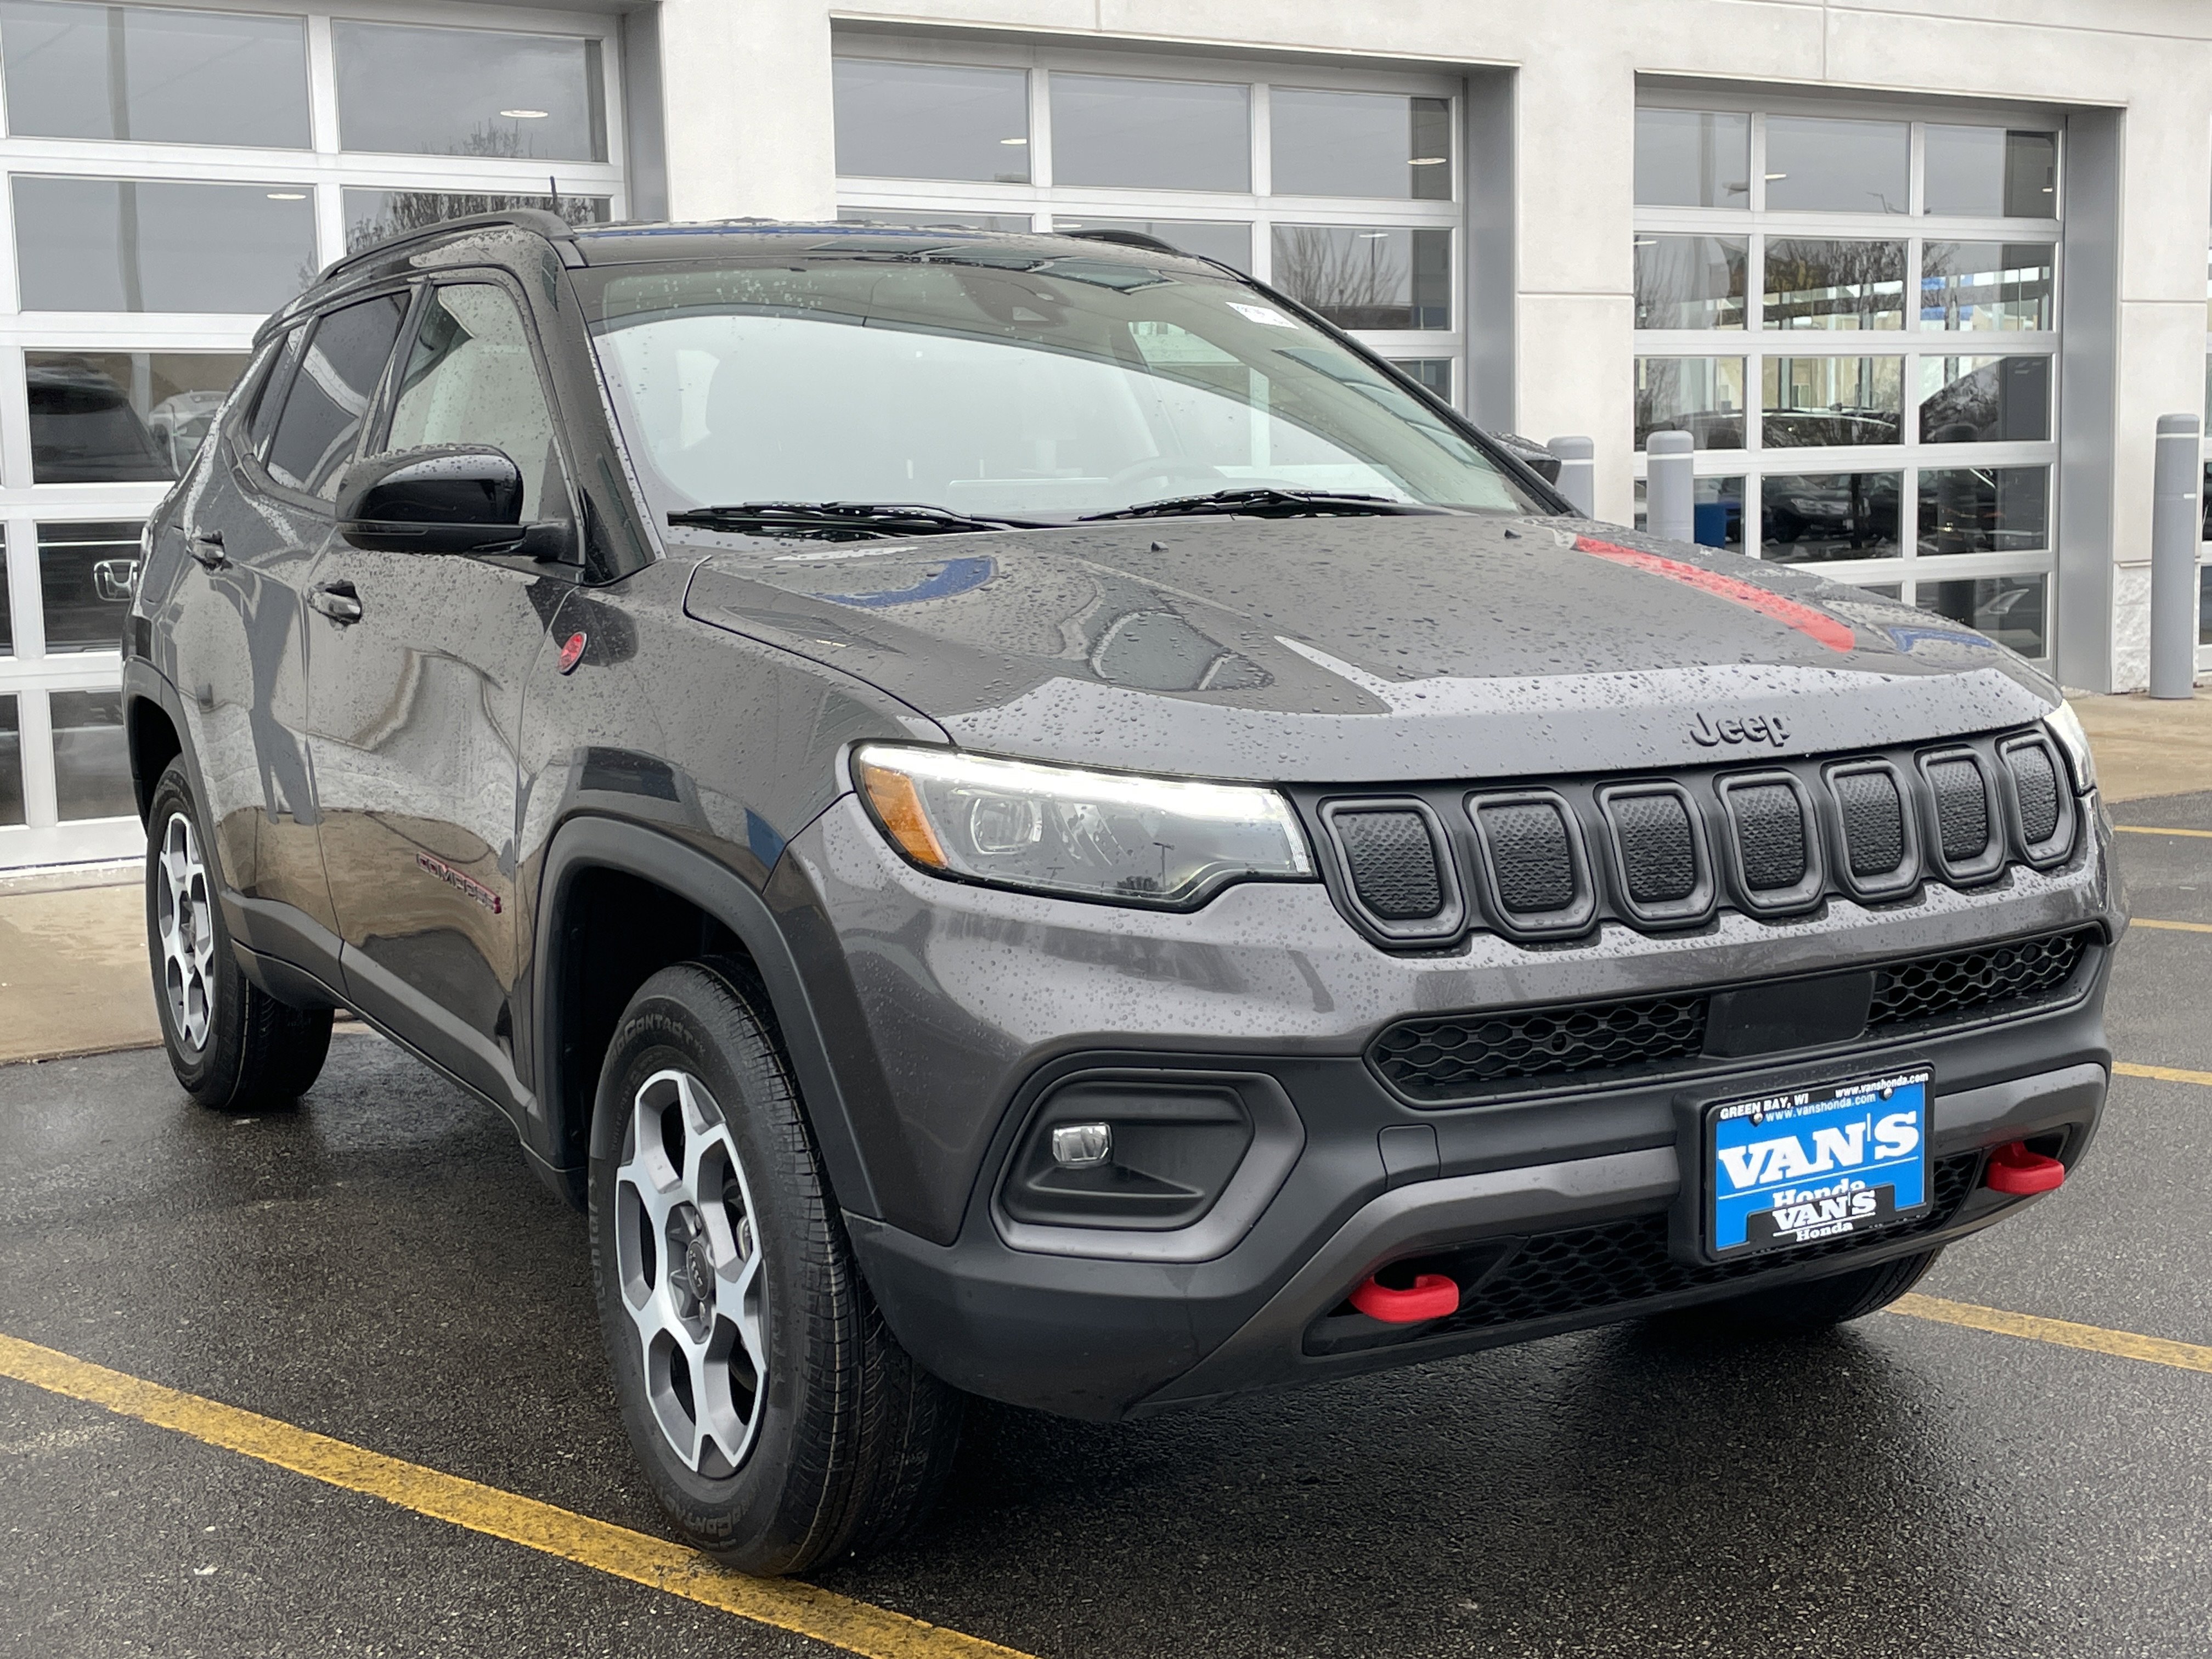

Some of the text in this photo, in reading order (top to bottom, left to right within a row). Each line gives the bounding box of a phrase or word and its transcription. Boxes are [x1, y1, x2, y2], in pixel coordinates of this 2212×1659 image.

[1690, 712, 1791, 747] Jeep
[1835, 1073, 1928, 1098] www.vanshonda.com
[1720, 1093, 1809, 1120] GREEN BAY, WI
[1765, 1093, 1876, 1122] www.vanshonda.com
[1718, 1110, 1919, 1189] VAN'S
[1773, 1178, 1866, 1207] Honda
[1772, 1189, 1877, 1231] VAN'S
[1796, 1222, 1854, 1242] Honda
